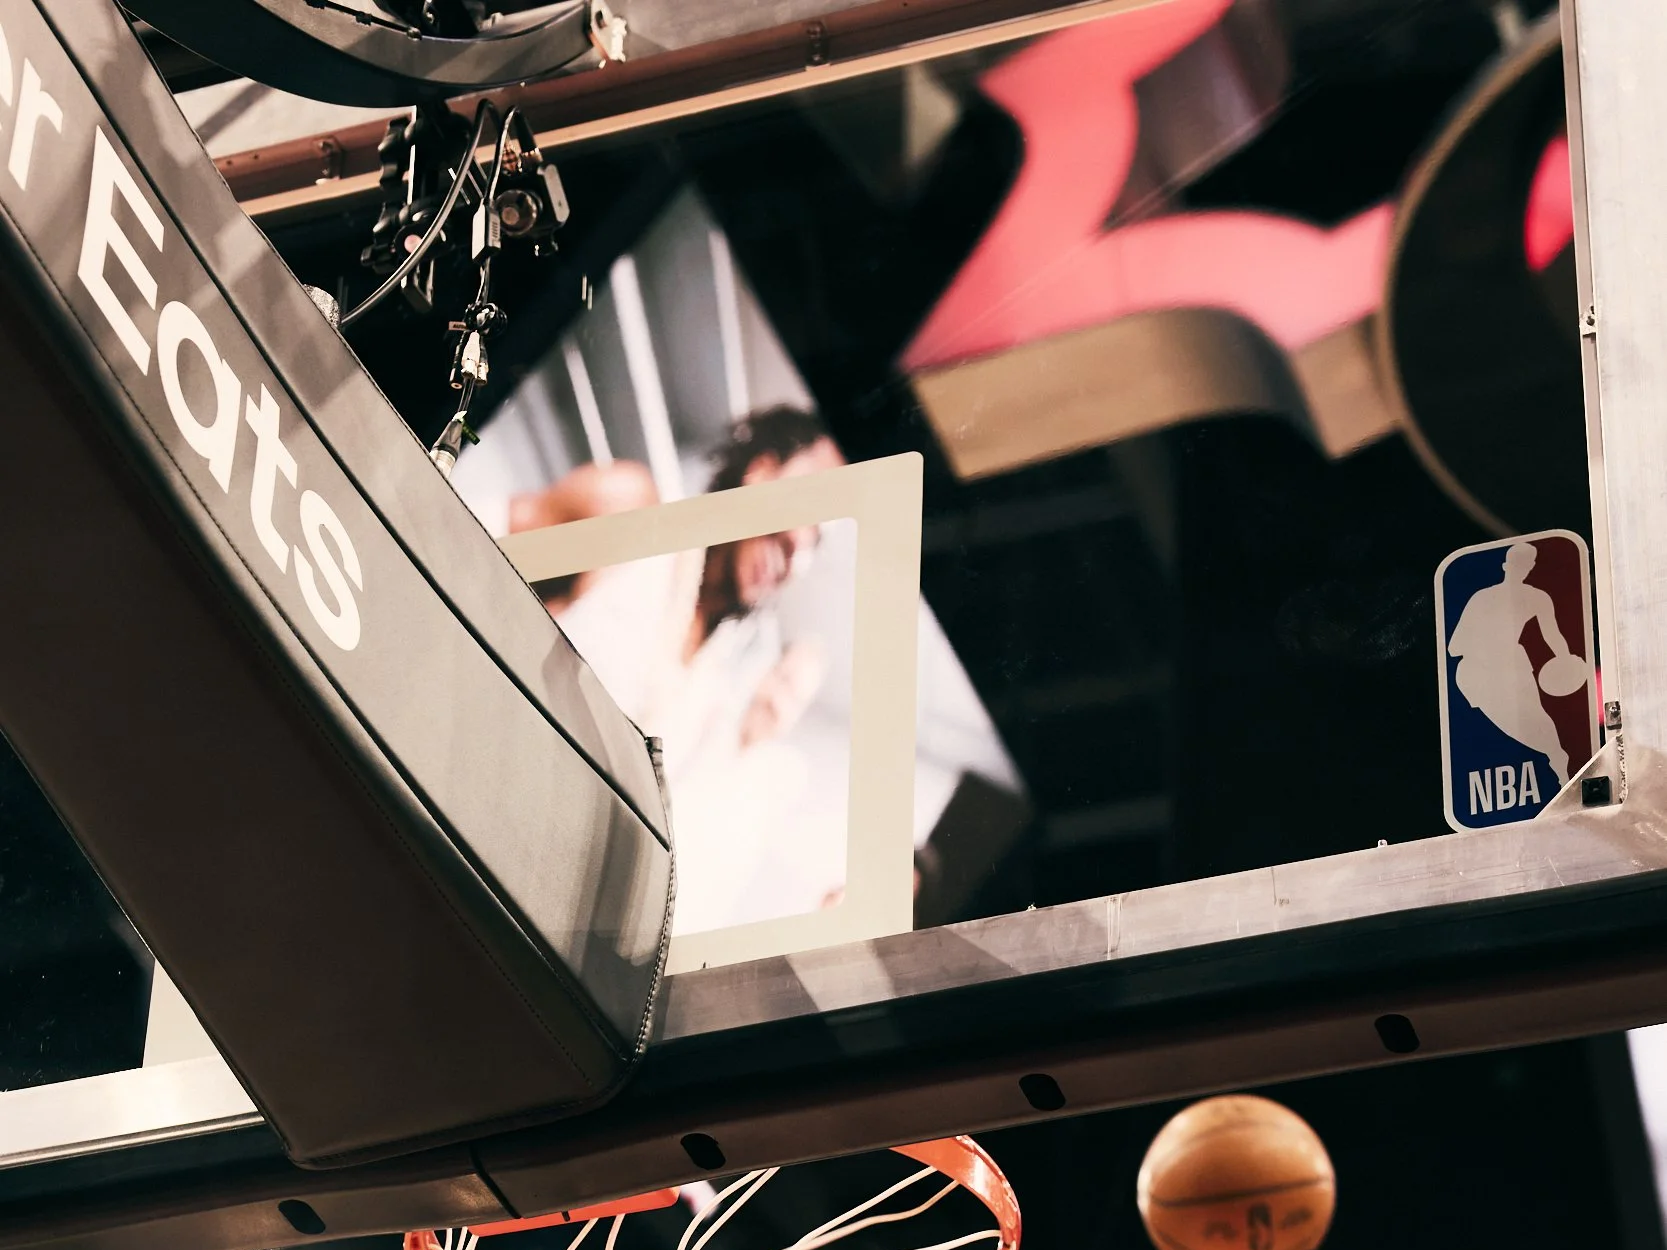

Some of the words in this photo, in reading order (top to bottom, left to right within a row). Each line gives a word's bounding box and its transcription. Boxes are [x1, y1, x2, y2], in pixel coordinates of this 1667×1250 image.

[0, 24, 63, 190] r
[78, 126, 363, 651] Eats
[1469, 761, 1541, 815] NBA
